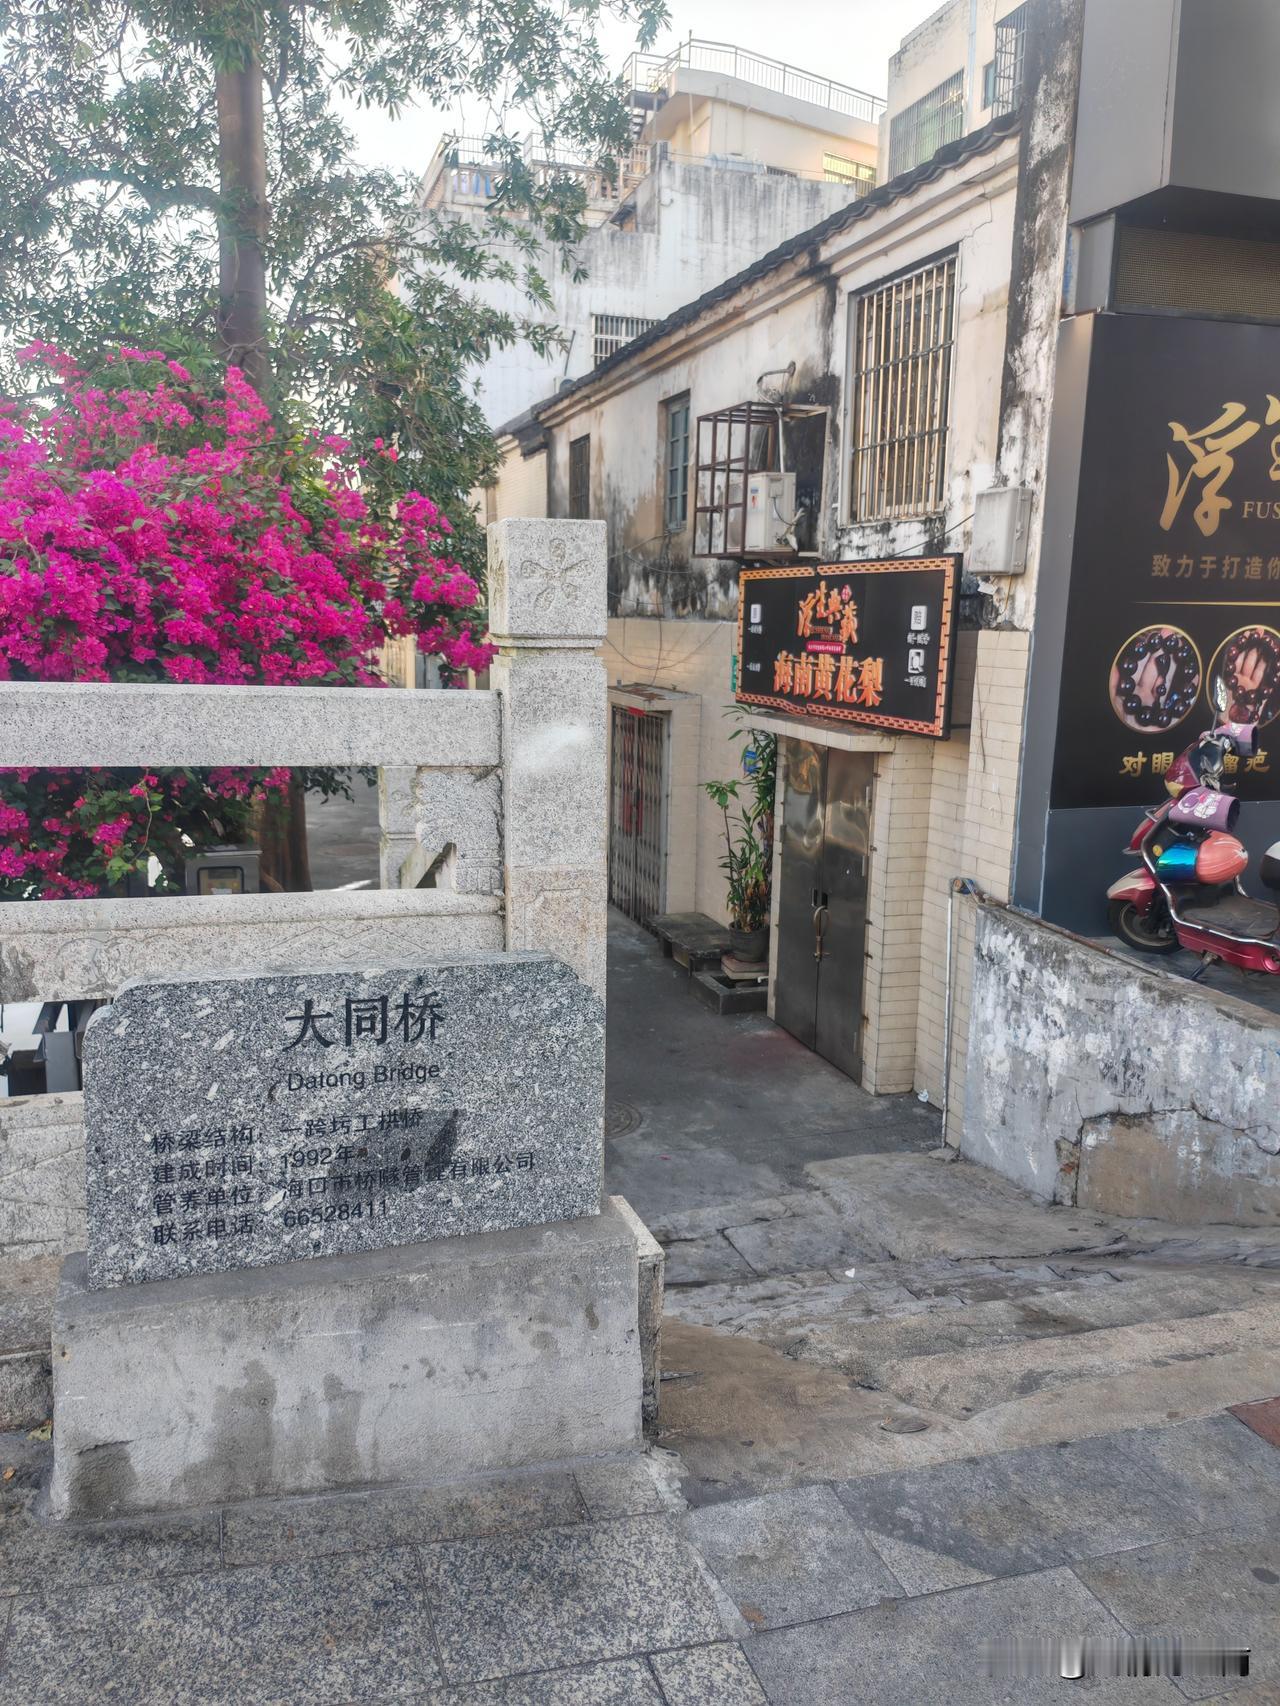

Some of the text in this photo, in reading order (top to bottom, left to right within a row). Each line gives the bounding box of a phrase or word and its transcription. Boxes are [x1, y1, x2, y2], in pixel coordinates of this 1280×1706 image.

[1151, 554, 1280, 579] 致力于打造你
[773, 650, 884, 708] 海南黄花梨
[282, 991, 445, 1052] 大同桥
[287, 1062, 440, 1091] Datong Bridge
[280, 1107, 423, 1137] 一跨圬工拱桥
[281, 1144, 355, 1169] 1992年
[282, 1152, 535, 1199] 海口市桥隧管理有限公司
[284, 1199, 387, 1227] 66528411
